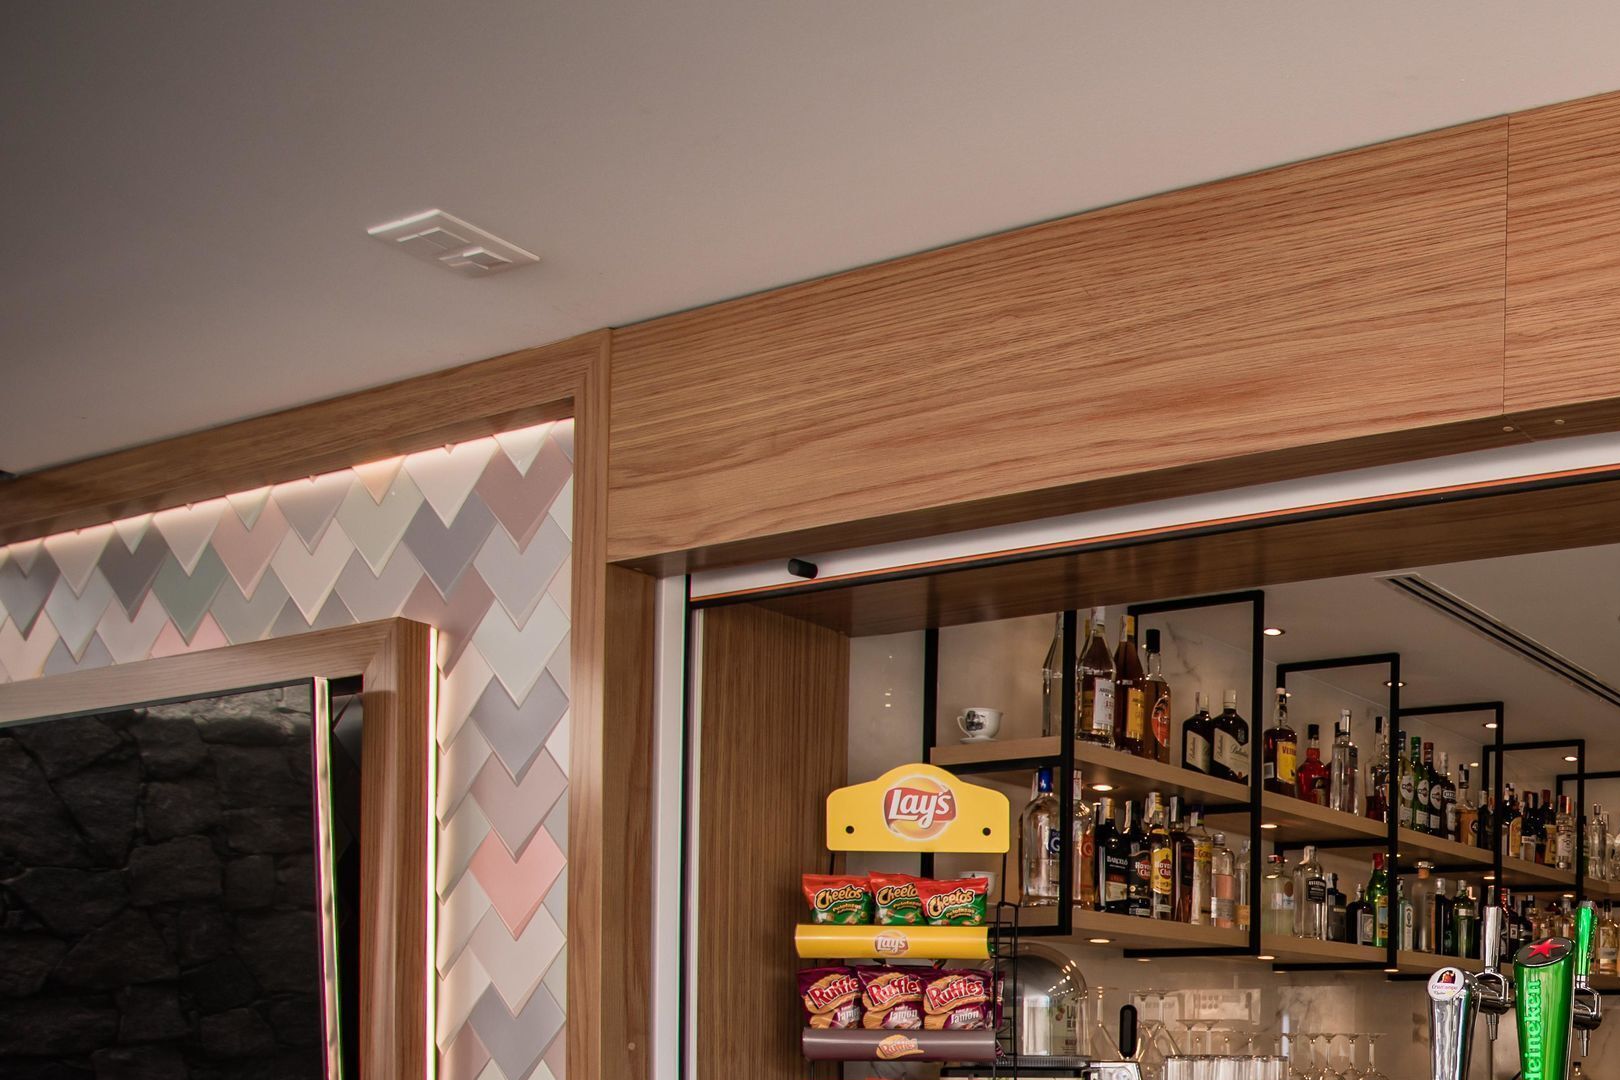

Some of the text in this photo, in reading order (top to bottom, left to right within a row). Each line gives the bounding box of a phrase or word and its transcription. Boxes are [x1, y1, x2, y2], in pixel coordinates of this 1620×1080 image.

[888, 789, 952, 829] Lay's
[815, 886, 863, 910] Cheetos
[876, 884, 920, 904] Cheeto
[927, 889, 975, 918] Cheetos
[807, 974, 858, 1009] Ruffle
[926, 978, 984, 1009] Ruffles
